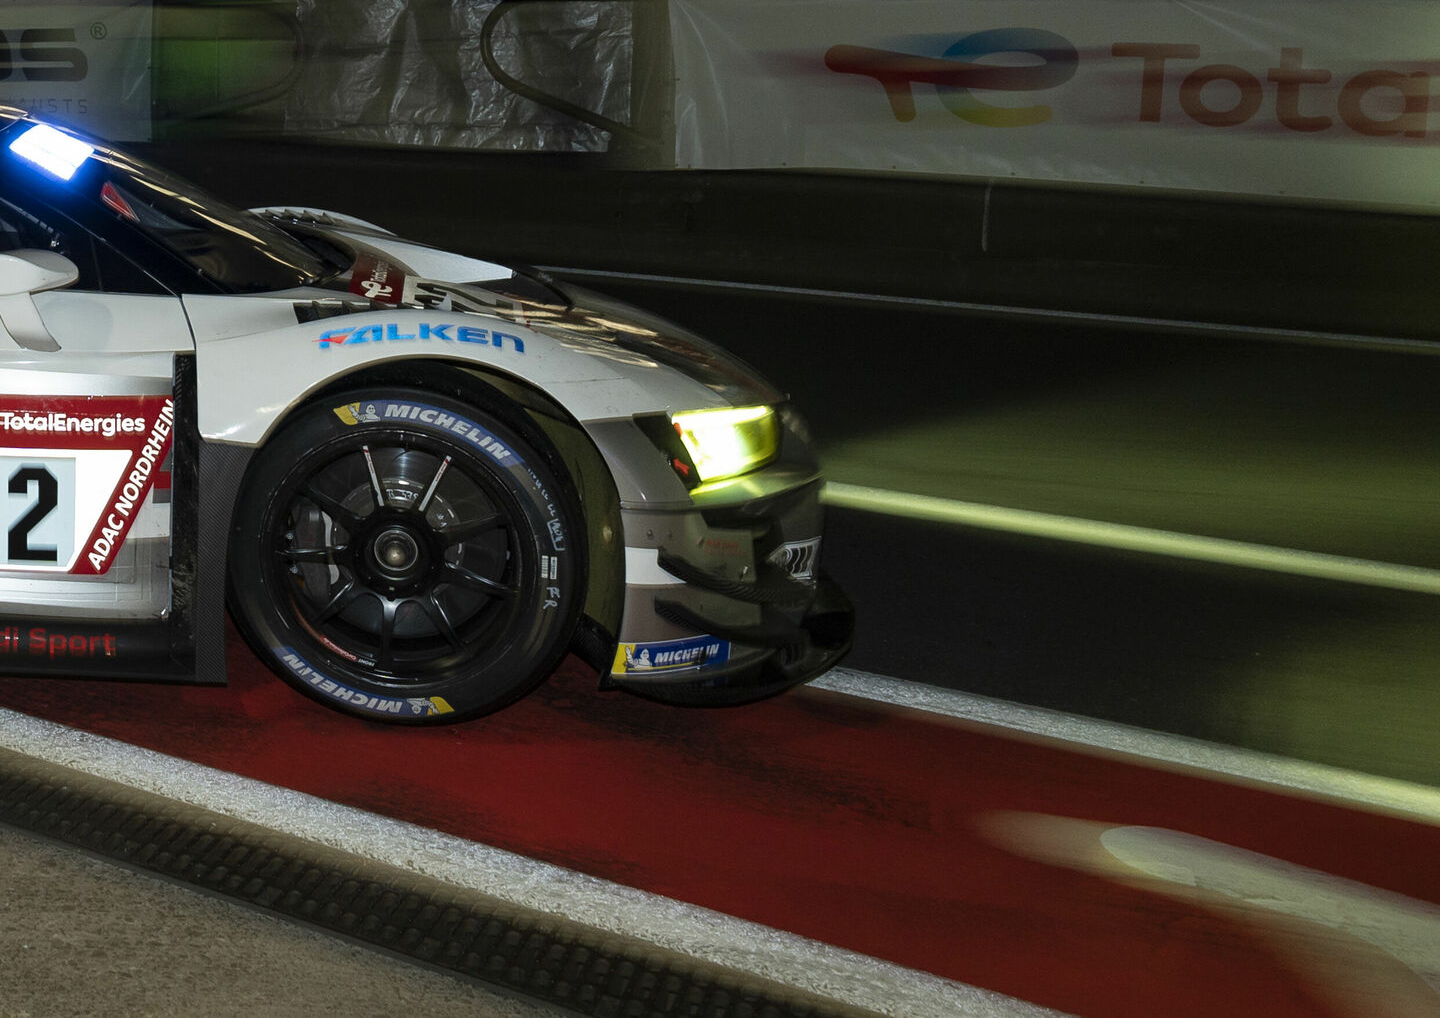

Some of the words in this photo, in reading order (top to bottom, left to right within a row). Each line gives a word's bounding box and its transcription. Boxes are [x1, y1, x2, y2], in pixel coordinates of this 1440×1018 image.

[314, 323, 525, 354] FALKEN
[0, 411, 146, 437] TotalEnergies
[385, 403, 512, 461] MICHELIN
[88, 513, 125, 572] ADAC
[114, 399, 173, 517] NORDRHEIN
[28, 627, 117, 659] Sport
[654, 642, 720, 664] MICHELIN
[283, 653, 403, 713] MICHELIN
